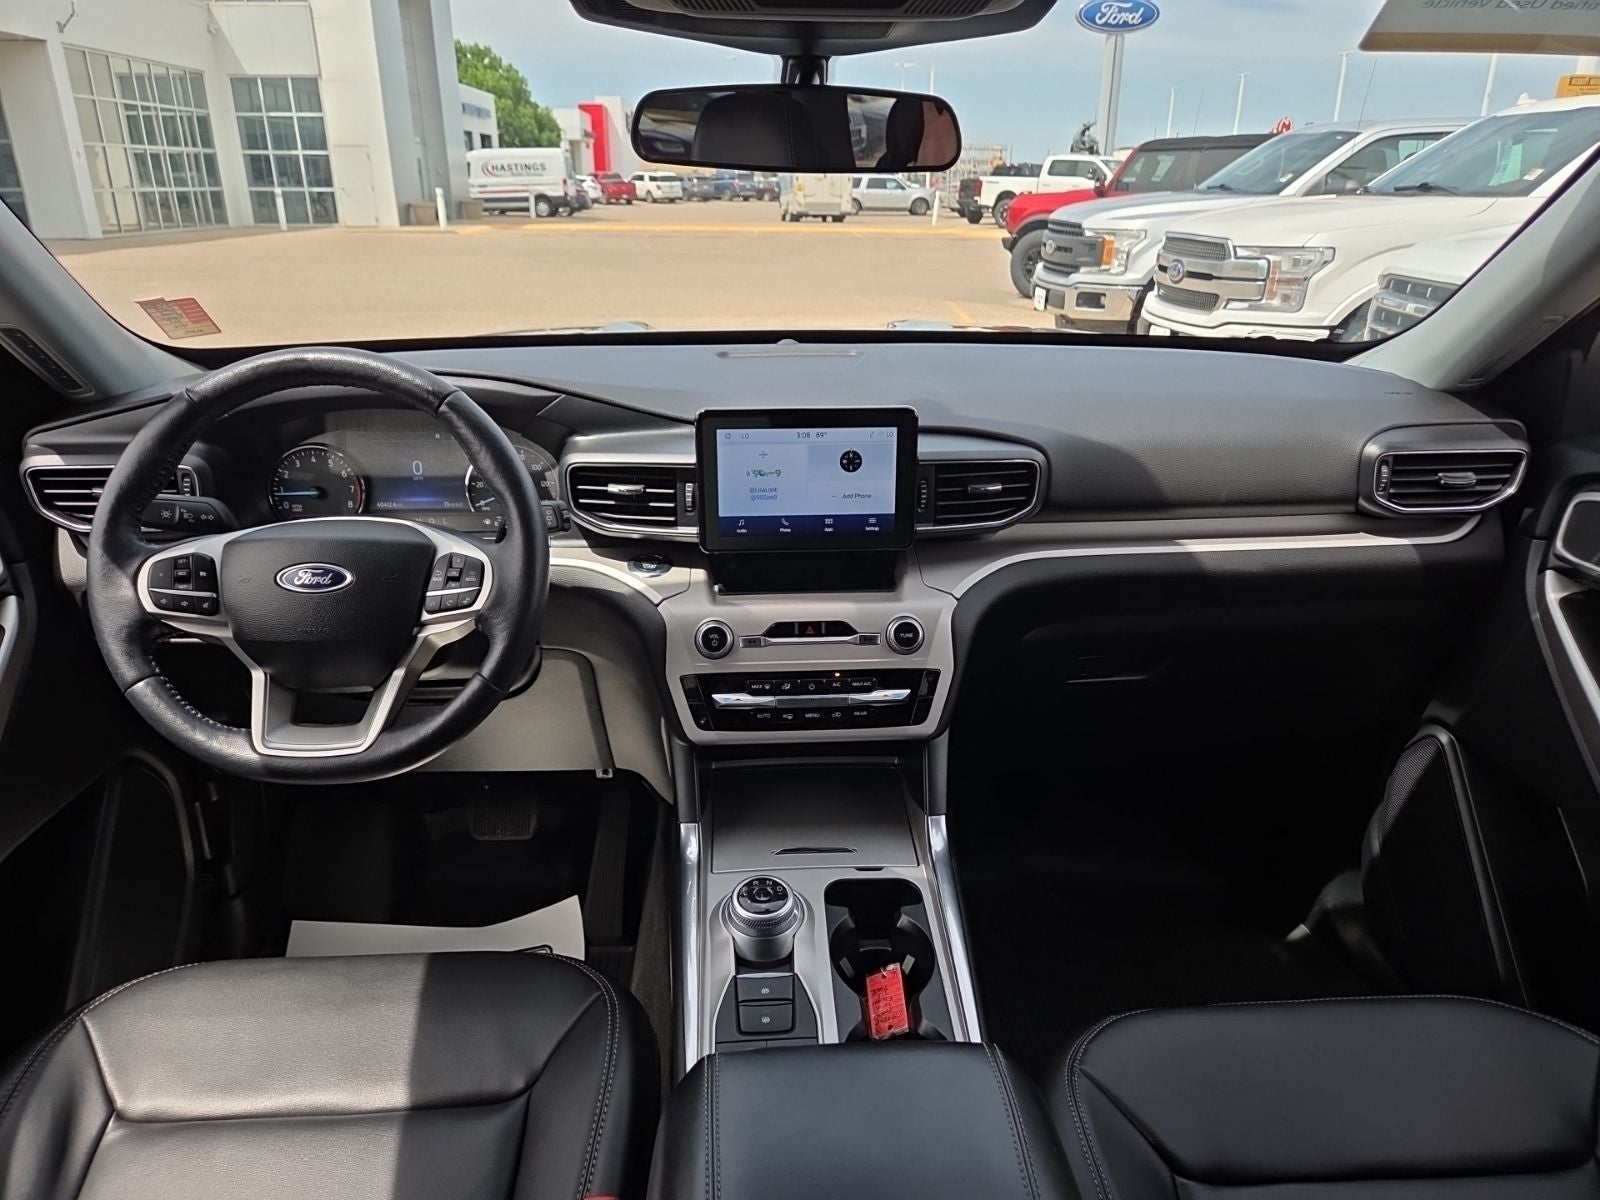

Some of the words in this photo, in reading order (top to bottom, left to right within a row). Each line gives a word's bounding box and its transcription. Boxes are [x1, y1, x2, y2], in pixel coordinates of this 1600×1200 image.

[1095, 1, 1145, 25] Ford
[491, 162, 546, 172] HASTINGS
[796, 431, 811, 439] 3:08
[295, 459, 300, 468] 3
[327, 459, 334, 468] 5
[283, 470, 289, 479] 2
[341, 470, 347, 478] 6
[293, 568, 334, 585] Ford
